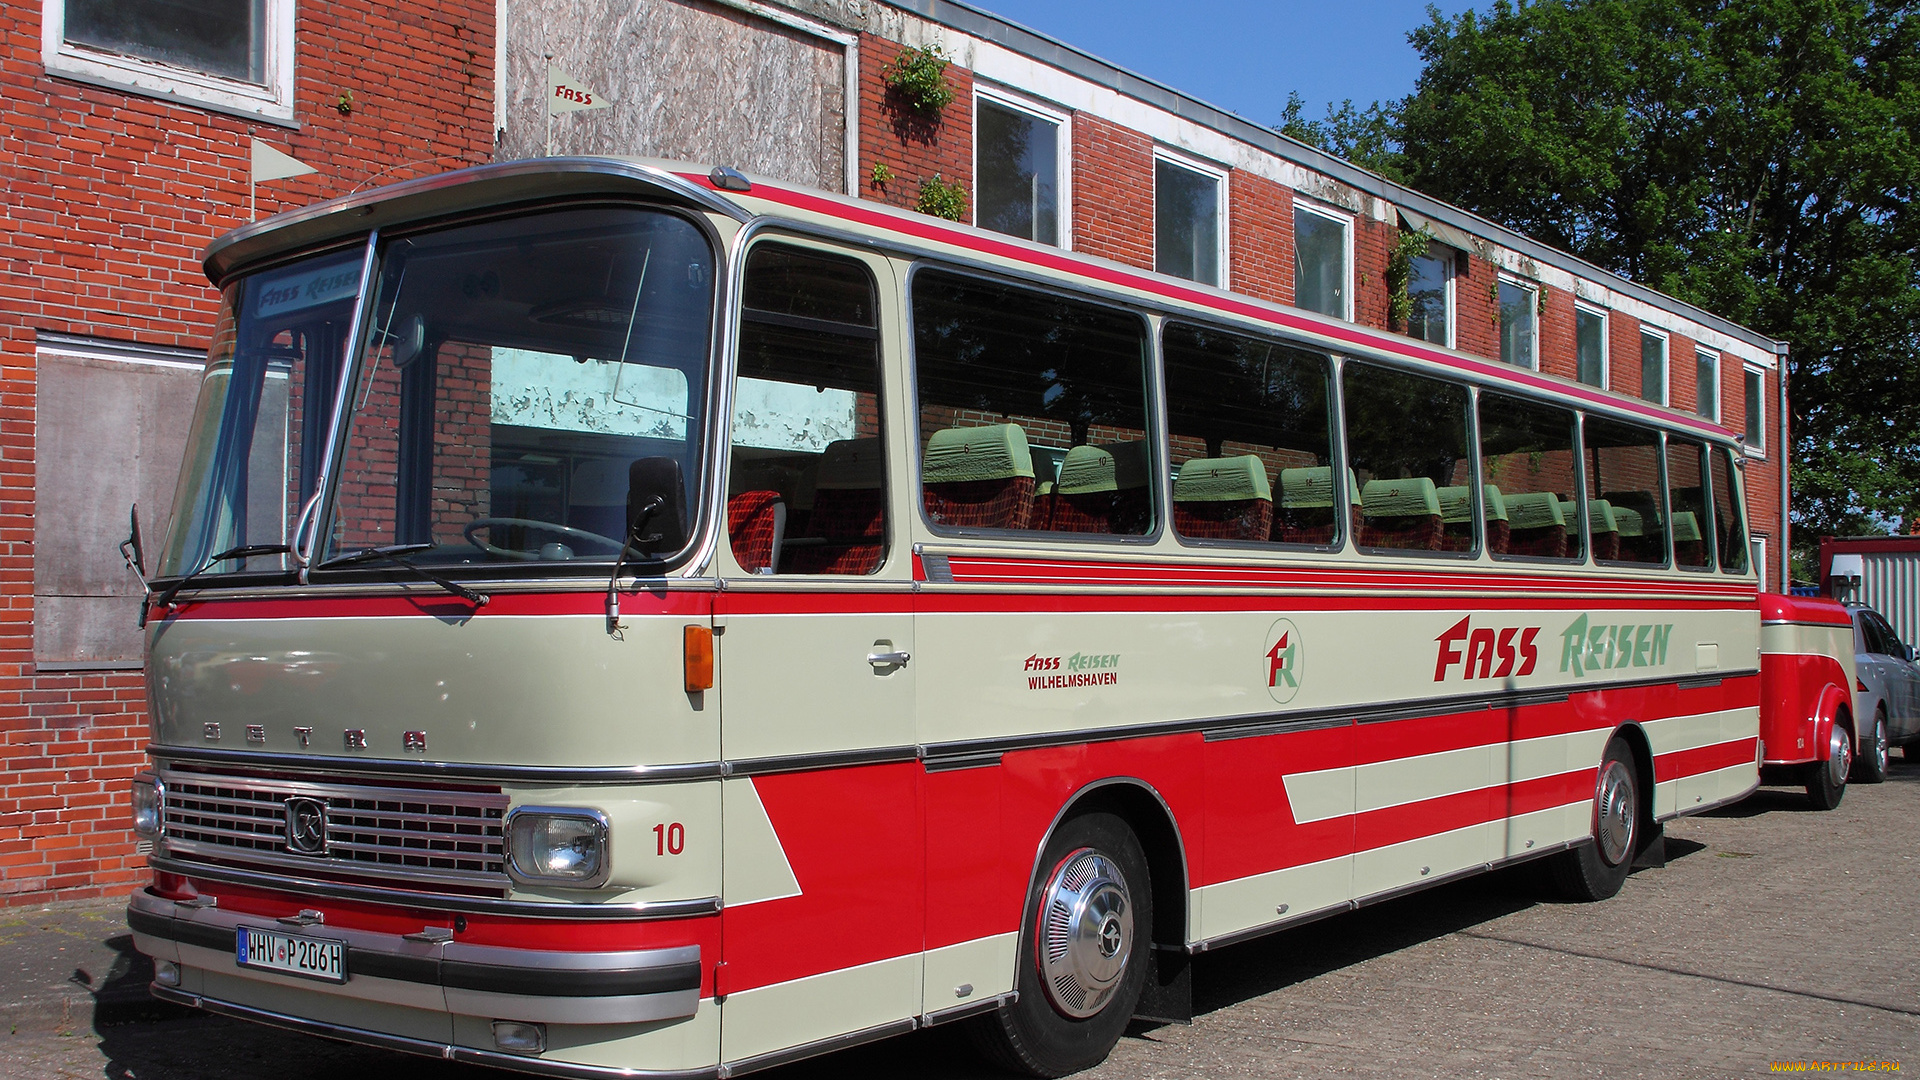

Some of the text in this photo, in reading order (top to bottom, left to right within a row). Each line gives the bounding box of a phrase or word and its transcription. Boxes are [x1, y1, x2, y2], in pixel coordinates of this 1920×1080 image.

[555, 85, 592, 105] FASS
[260, 287, 300, 309] FASS
[963, 443, 970, 454] 6
[1098, 456, 1107, 466] 10
[1434, 612, 1673, 681] FASS REISEN
[1024, 652, 1120, 672] FASS REISEN
[1028, 672, 1117, 690] WILHELMSHAVEN
[204, 722, 427, 750] SETRA
[653, 822, 685, 856] 10
[248, 932, 276, 962] WHV
